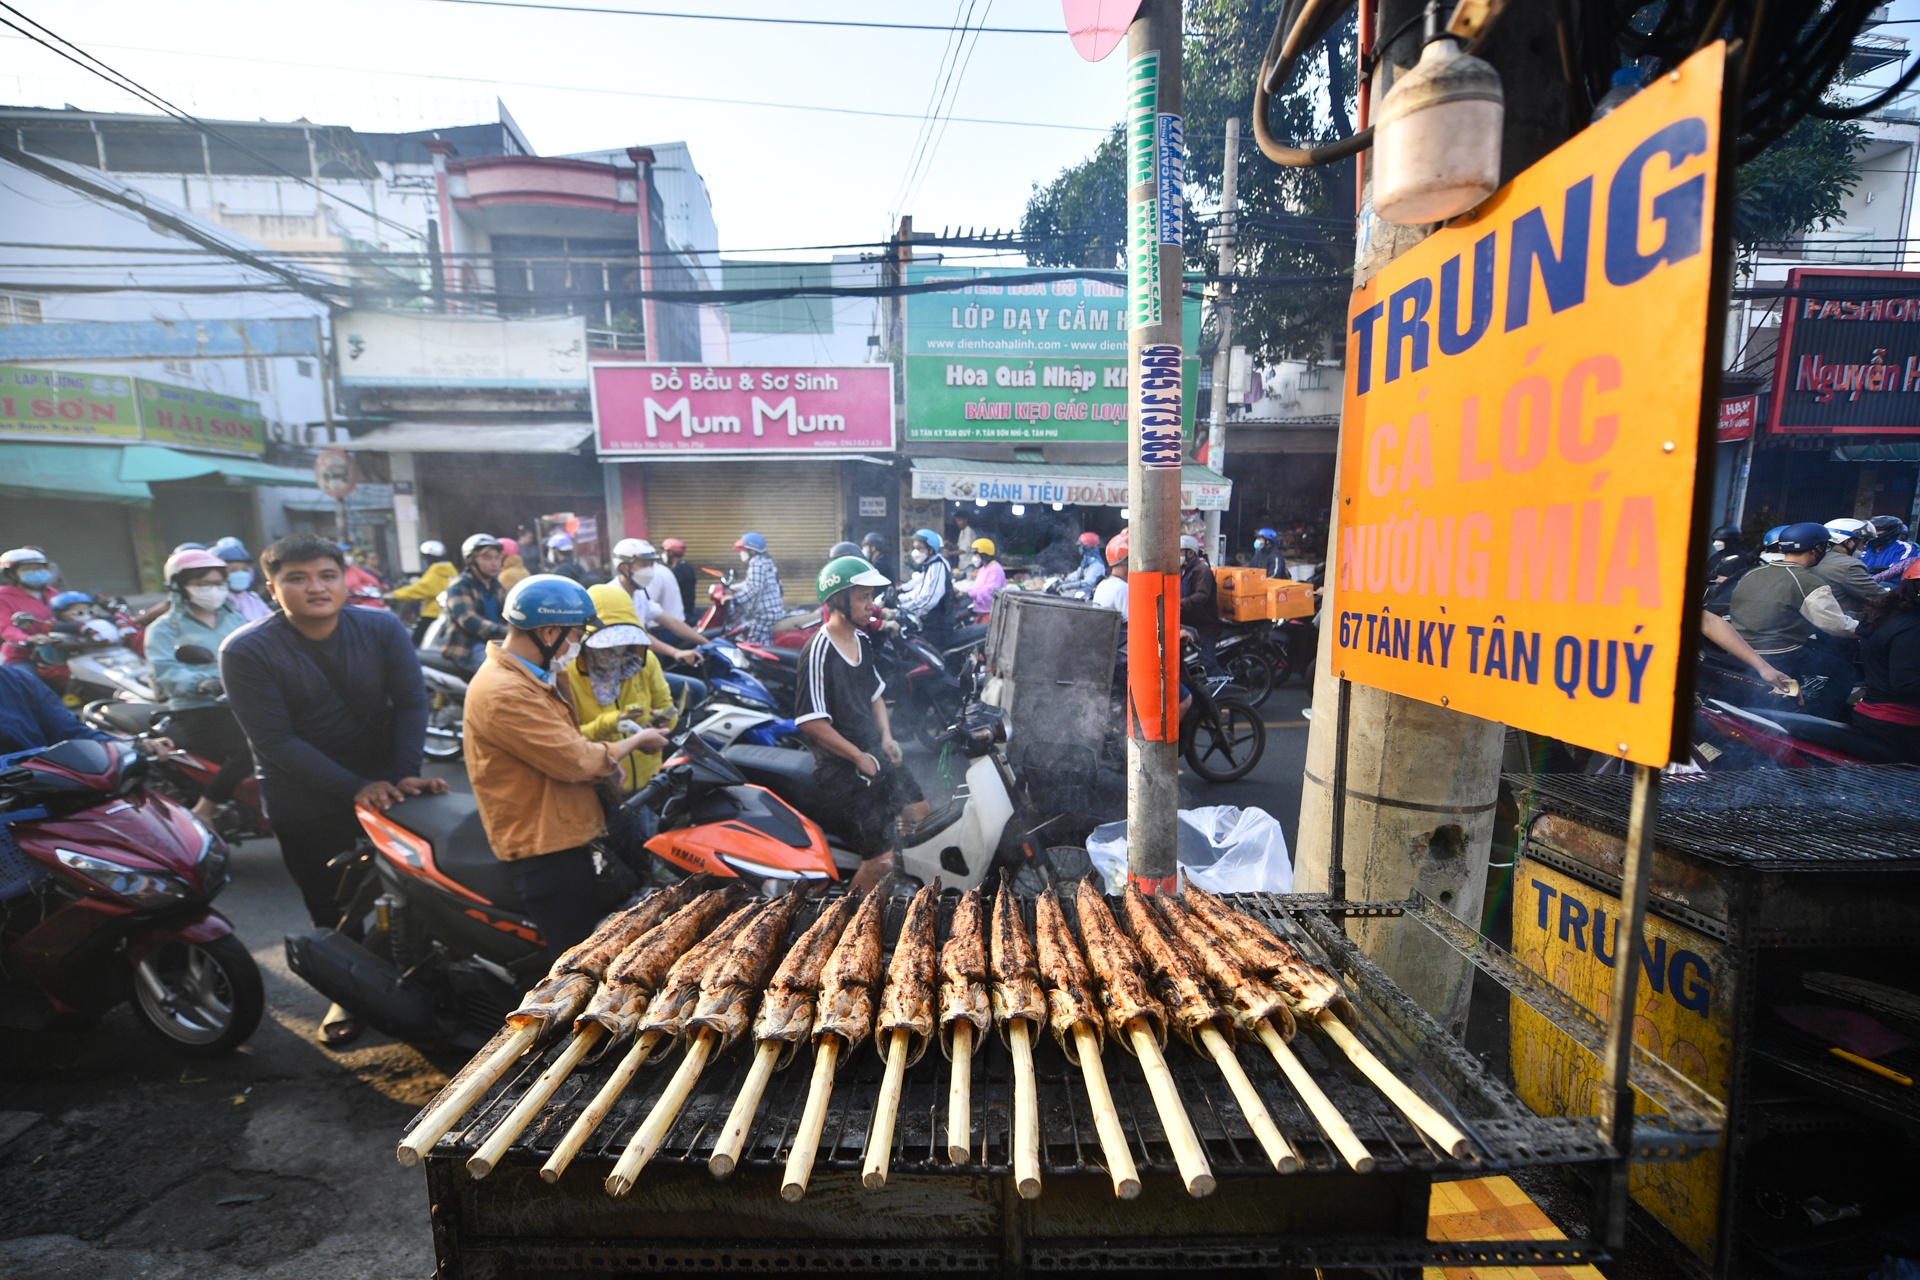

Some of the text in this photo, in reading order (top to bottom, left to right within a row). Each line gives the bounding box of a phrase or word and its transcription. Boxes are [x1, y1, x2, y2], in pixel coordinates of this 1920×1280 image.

[1161, 213, 1170, 241] HÚT
[1149, 200, 1161, 321] HÚT HẦM CẦU
[1352, 117, 1708, 397] TRUNG
[952, 301, 1128, 335] LỚP DẠY CẮM H
[1803, 298, 1920, 321] FASHION
[927, 340, 955, 349] www
[957, 338, 1061, 350] dienhoahalinh.com
[1071, 340, 1098, 350] www
[1100, 339, 1128, 351] dienh
[651, 367, 838, 391] Đồ Bầu & Sơ Sinh
[946, 361, 1128, 391] Hoa Quả Nhập Kh
[1796, 348, 1920, 402] Nguyễn H
[30, 397, 116, 423] SƠN
[644, 396, 845, 438] Mum Mum
[965, 398, 1011, 420] BÁNH
[1015, 402, 1050, 425] KẸO
[1054, 398, 1087, 421] CÁC
[1141, 345, 1182, 463] 0945.373.383
[156, 404, 254, 438] HẢI SƠN
[1367, 343, 1622, 498] CÁ LÓC
[979, 481, 1022, 500] BÁNH
[1029, 482, 1063, 501] TIÊU
[1341, 472, 1662, 609] NƯỚNG MÍA
[819, 573, 841, 591] Grab
[1339, 606, 1655, 705] 67 TÂN KỲ TÂN QUÝ
[671, 845, 705, 869] YAMAHA
